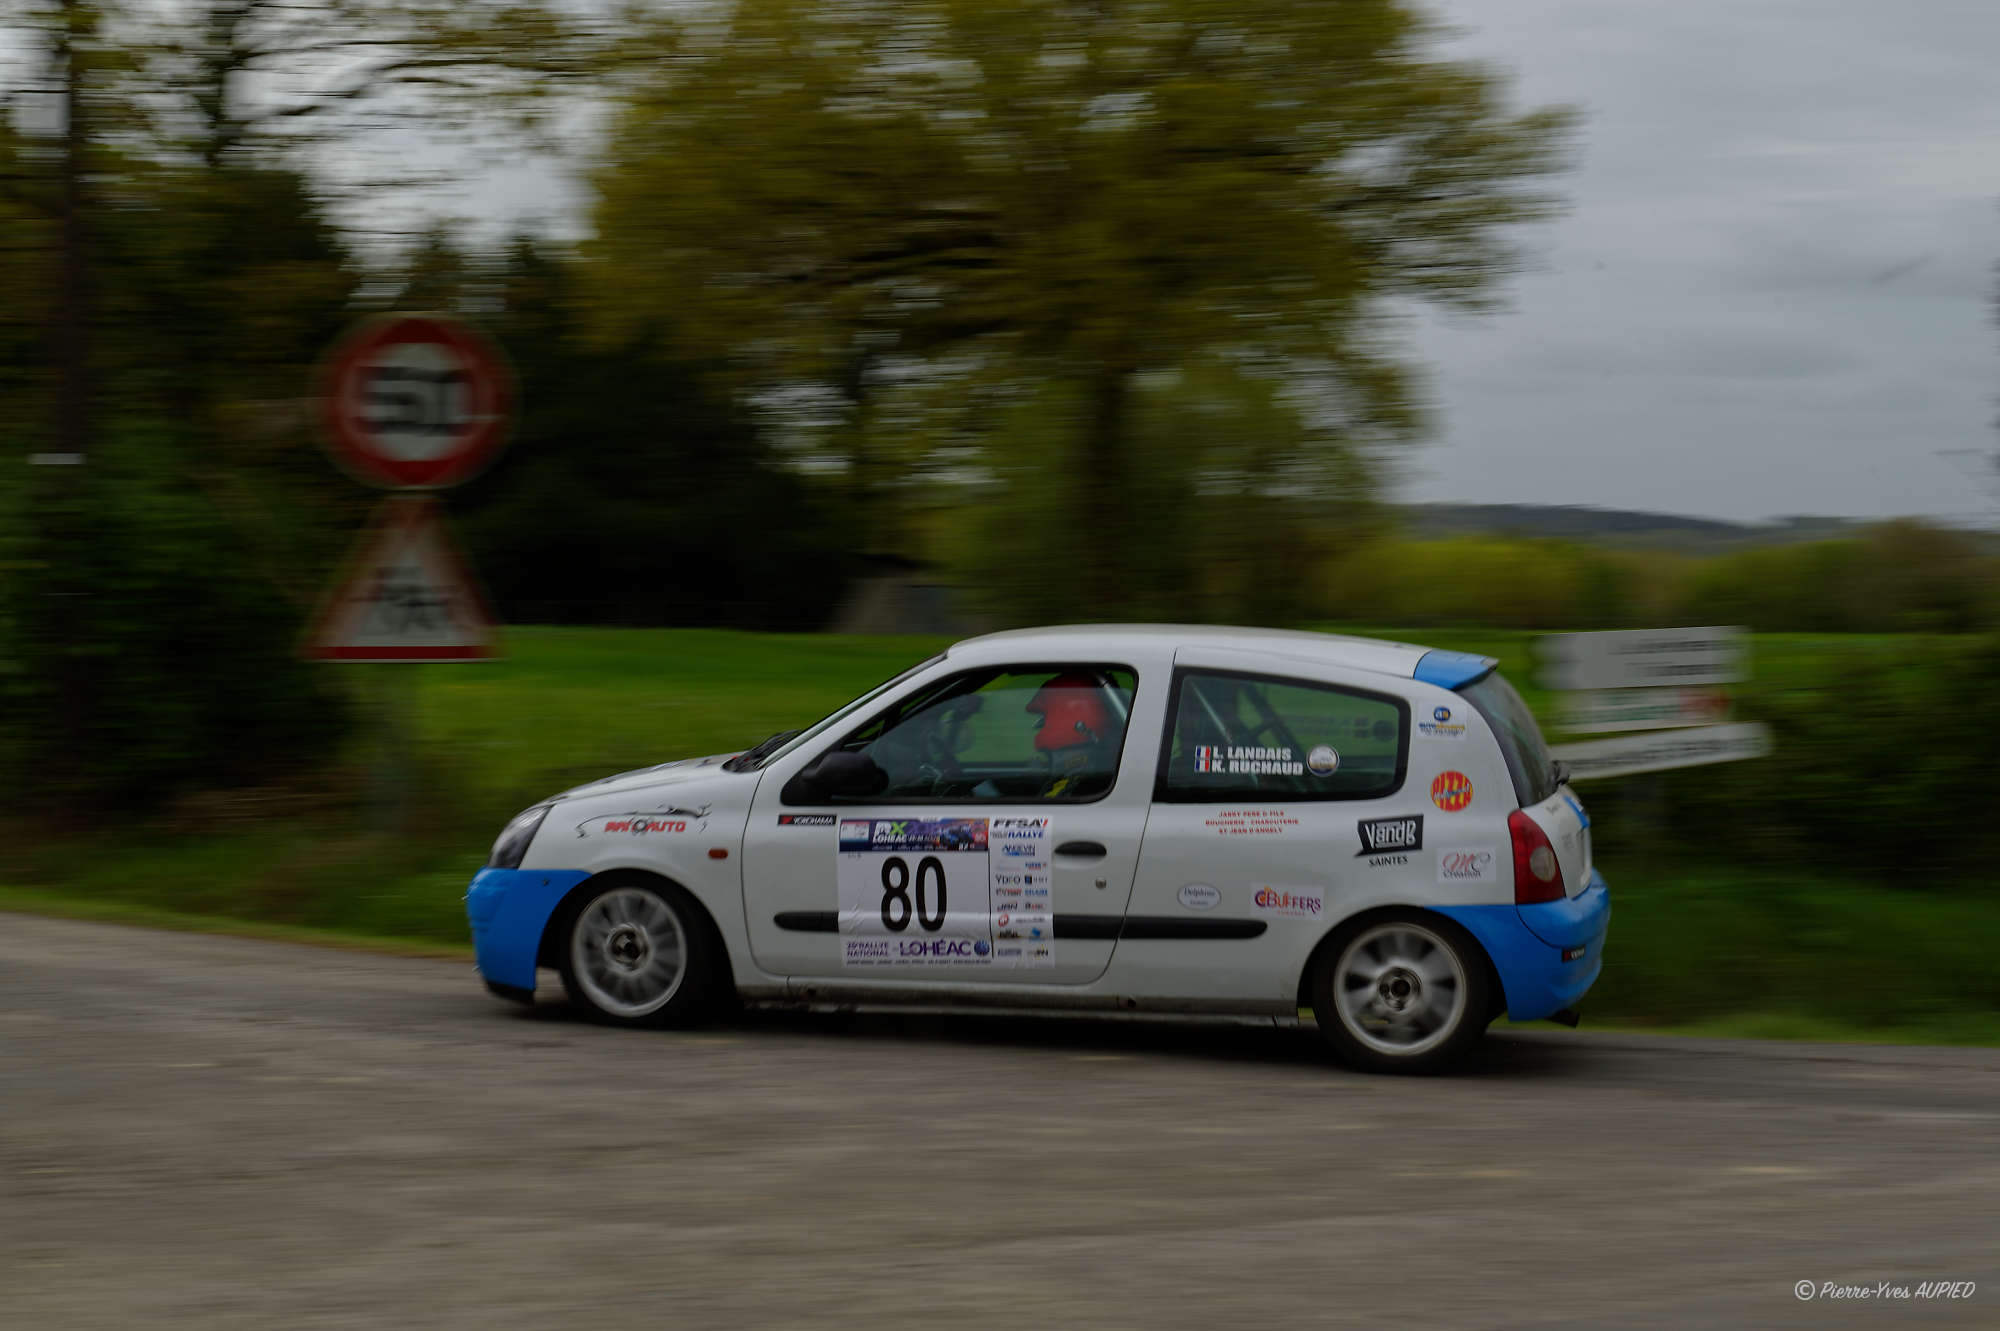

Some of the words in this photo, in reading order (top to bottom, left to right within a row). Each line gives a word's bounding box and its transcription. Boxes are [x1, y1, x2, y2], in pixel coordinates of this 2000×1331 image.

[1212, 746, 1224, 760] L.
[1227, 746, 1291, 761] LANDAIS
[1211, 760, 1226, 773] K.
[1229, 761, 1304, 776] RUCHAUD
[993, 819, 1042, 829] FFSA
[1368, 855, 1409, 868] SAINTES
[881, 855, 948, 933] 80
[847, 950, 889, 958] NATIONAL
[899, 939, 972, 957] LOHÉAC
